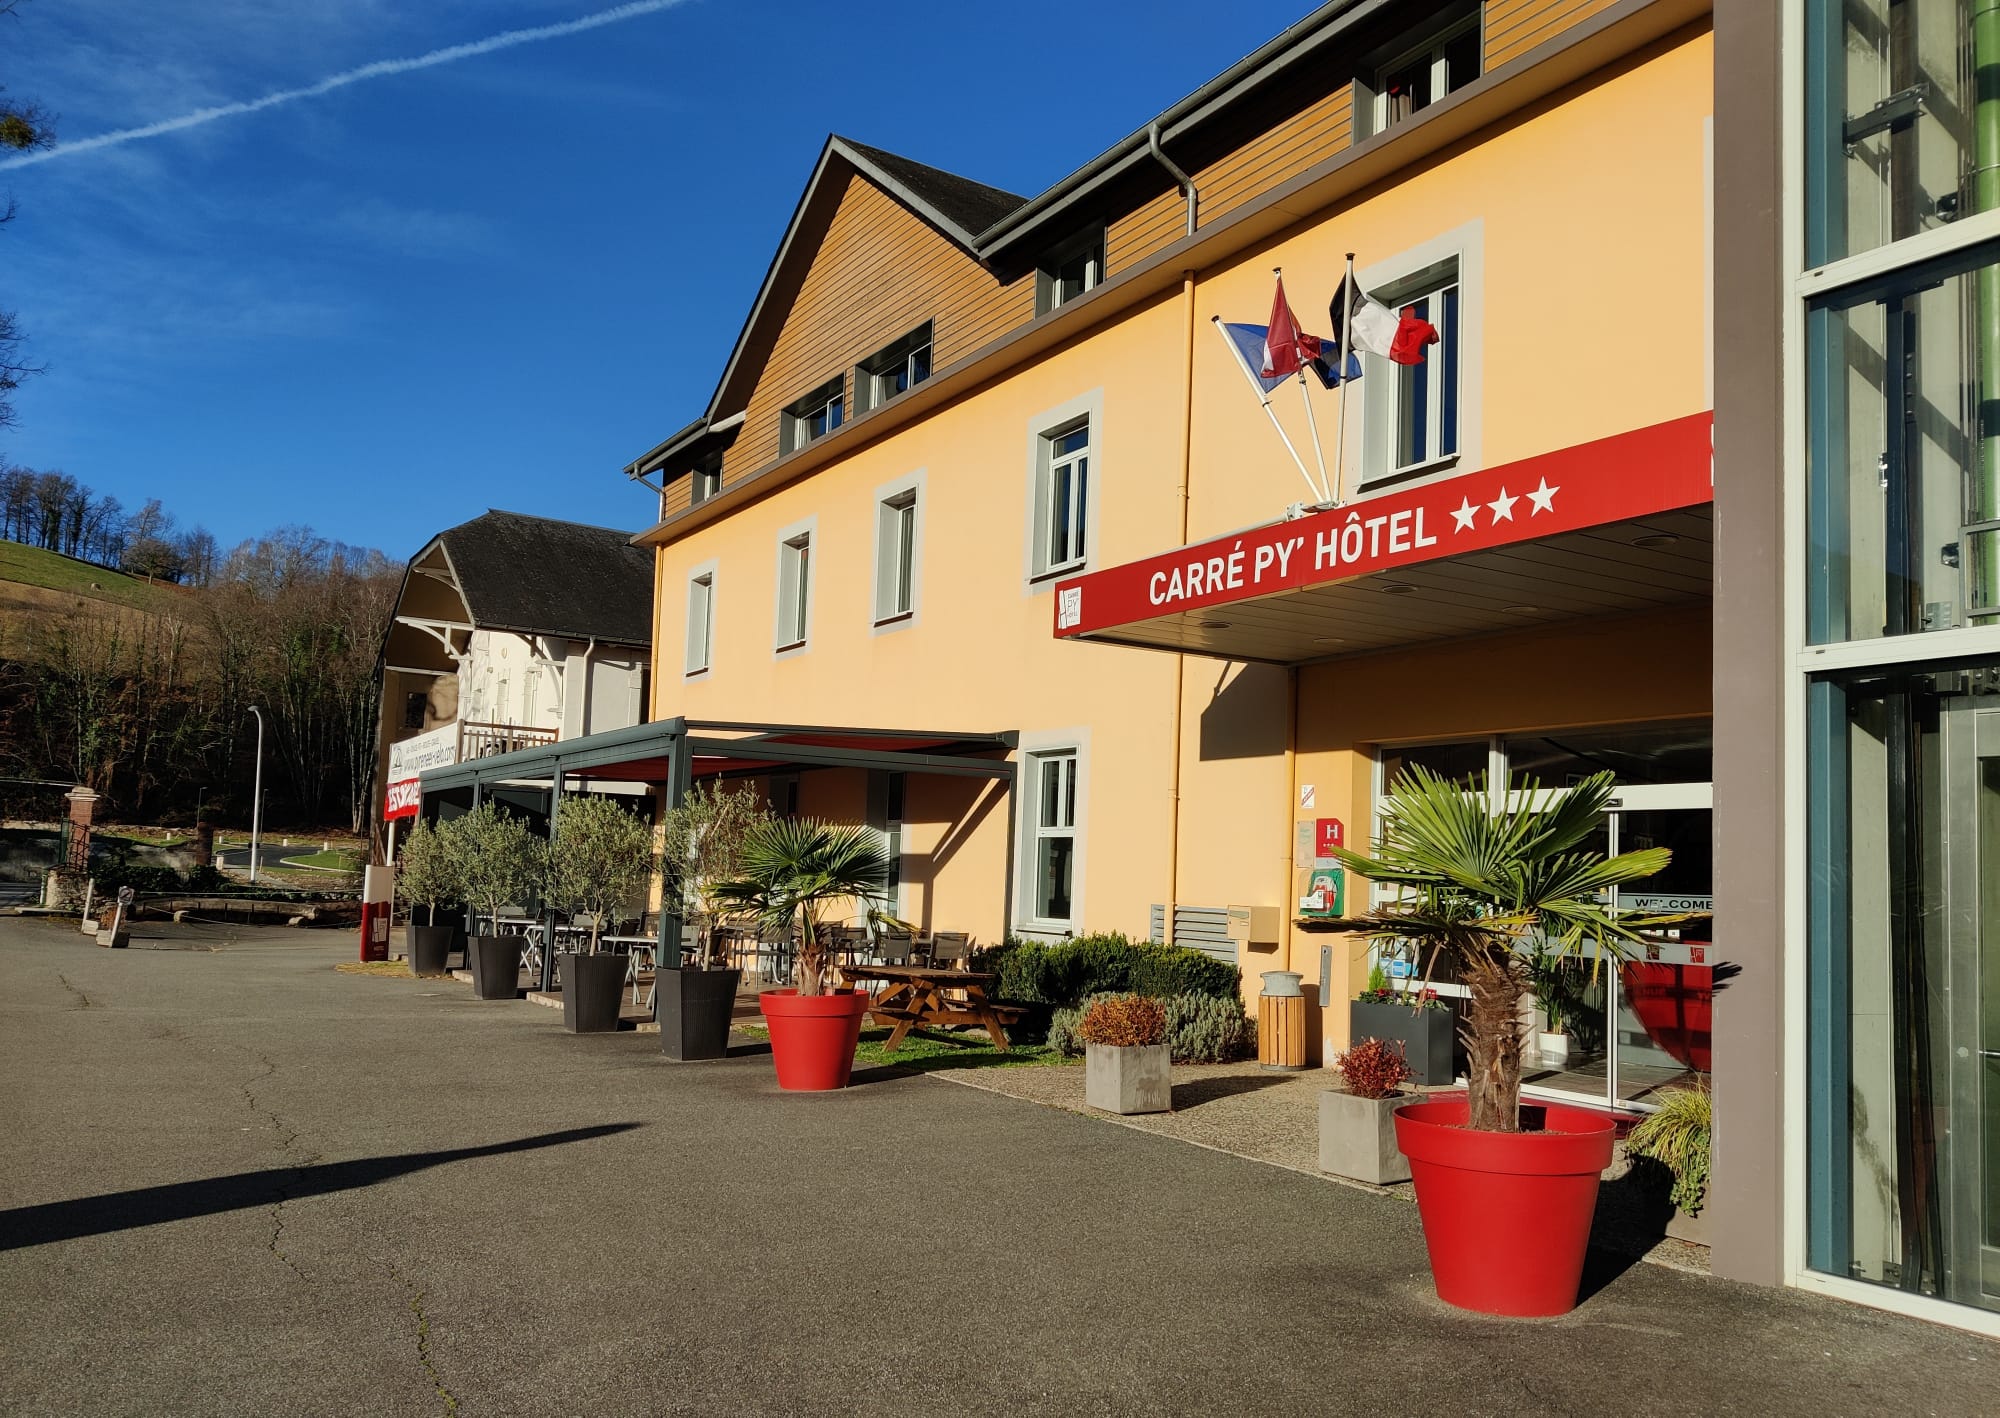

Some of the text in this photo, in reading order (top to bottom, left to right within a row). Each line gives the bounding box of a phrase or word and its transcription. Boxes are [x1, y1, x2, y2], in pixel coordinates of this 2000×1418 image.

[1150, 541, 1245, 605] CARRÉ
[1315, 506, 1437, 570] HÔTEL
[1326, 824, 1338, 839] H
